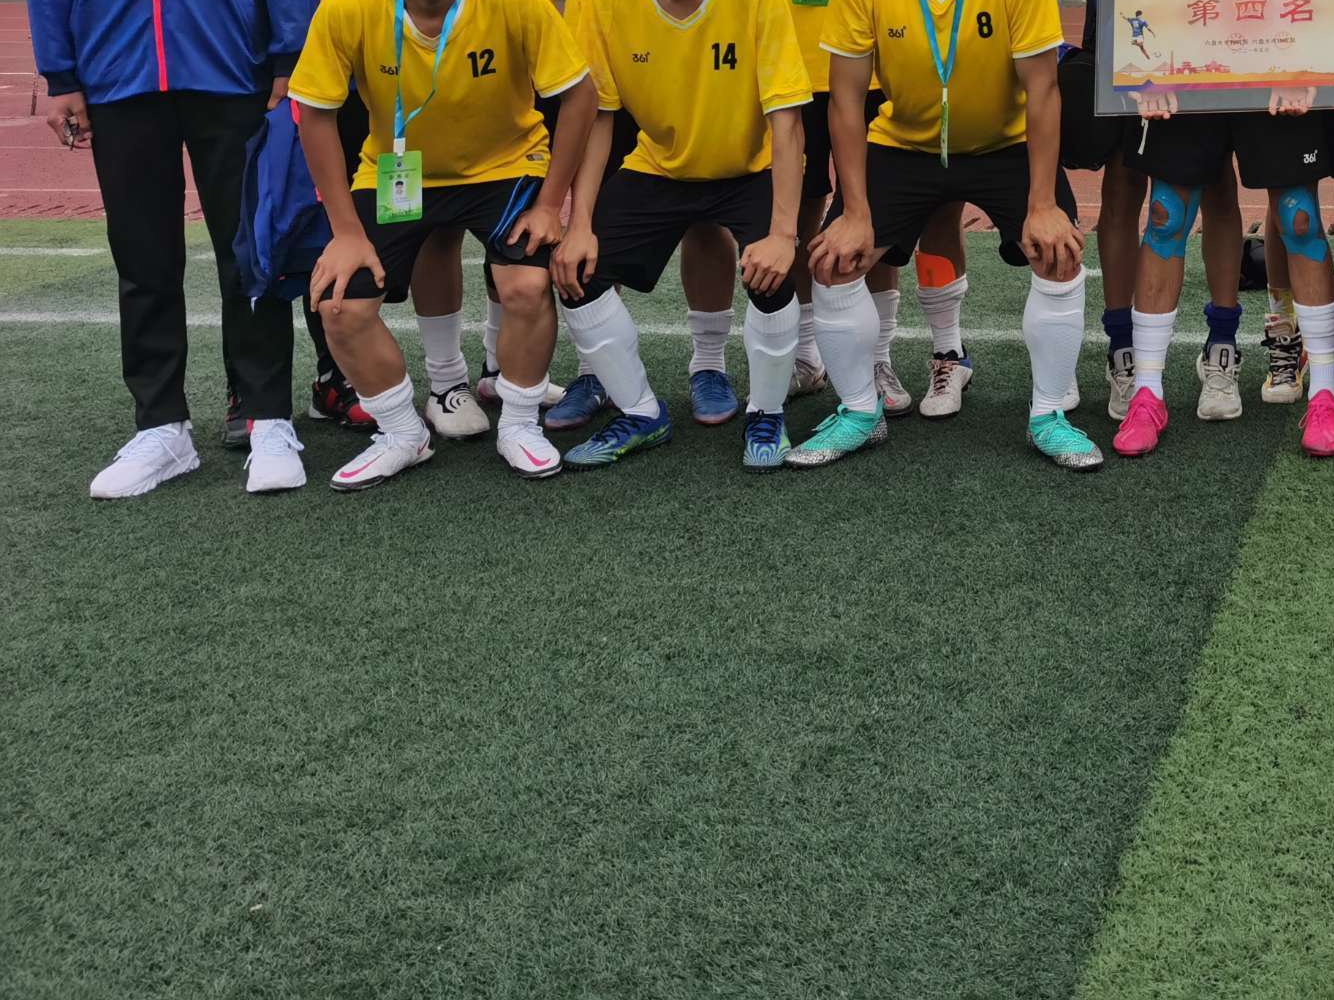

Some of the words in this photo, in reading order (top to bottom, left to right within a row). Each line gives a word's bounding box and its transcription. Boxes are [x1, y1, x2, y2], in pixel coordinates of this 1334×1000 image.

[976, 11, 993, 39] 8
[466, 48, 497, 79] 12
[711, 42, 738, 70] 14
